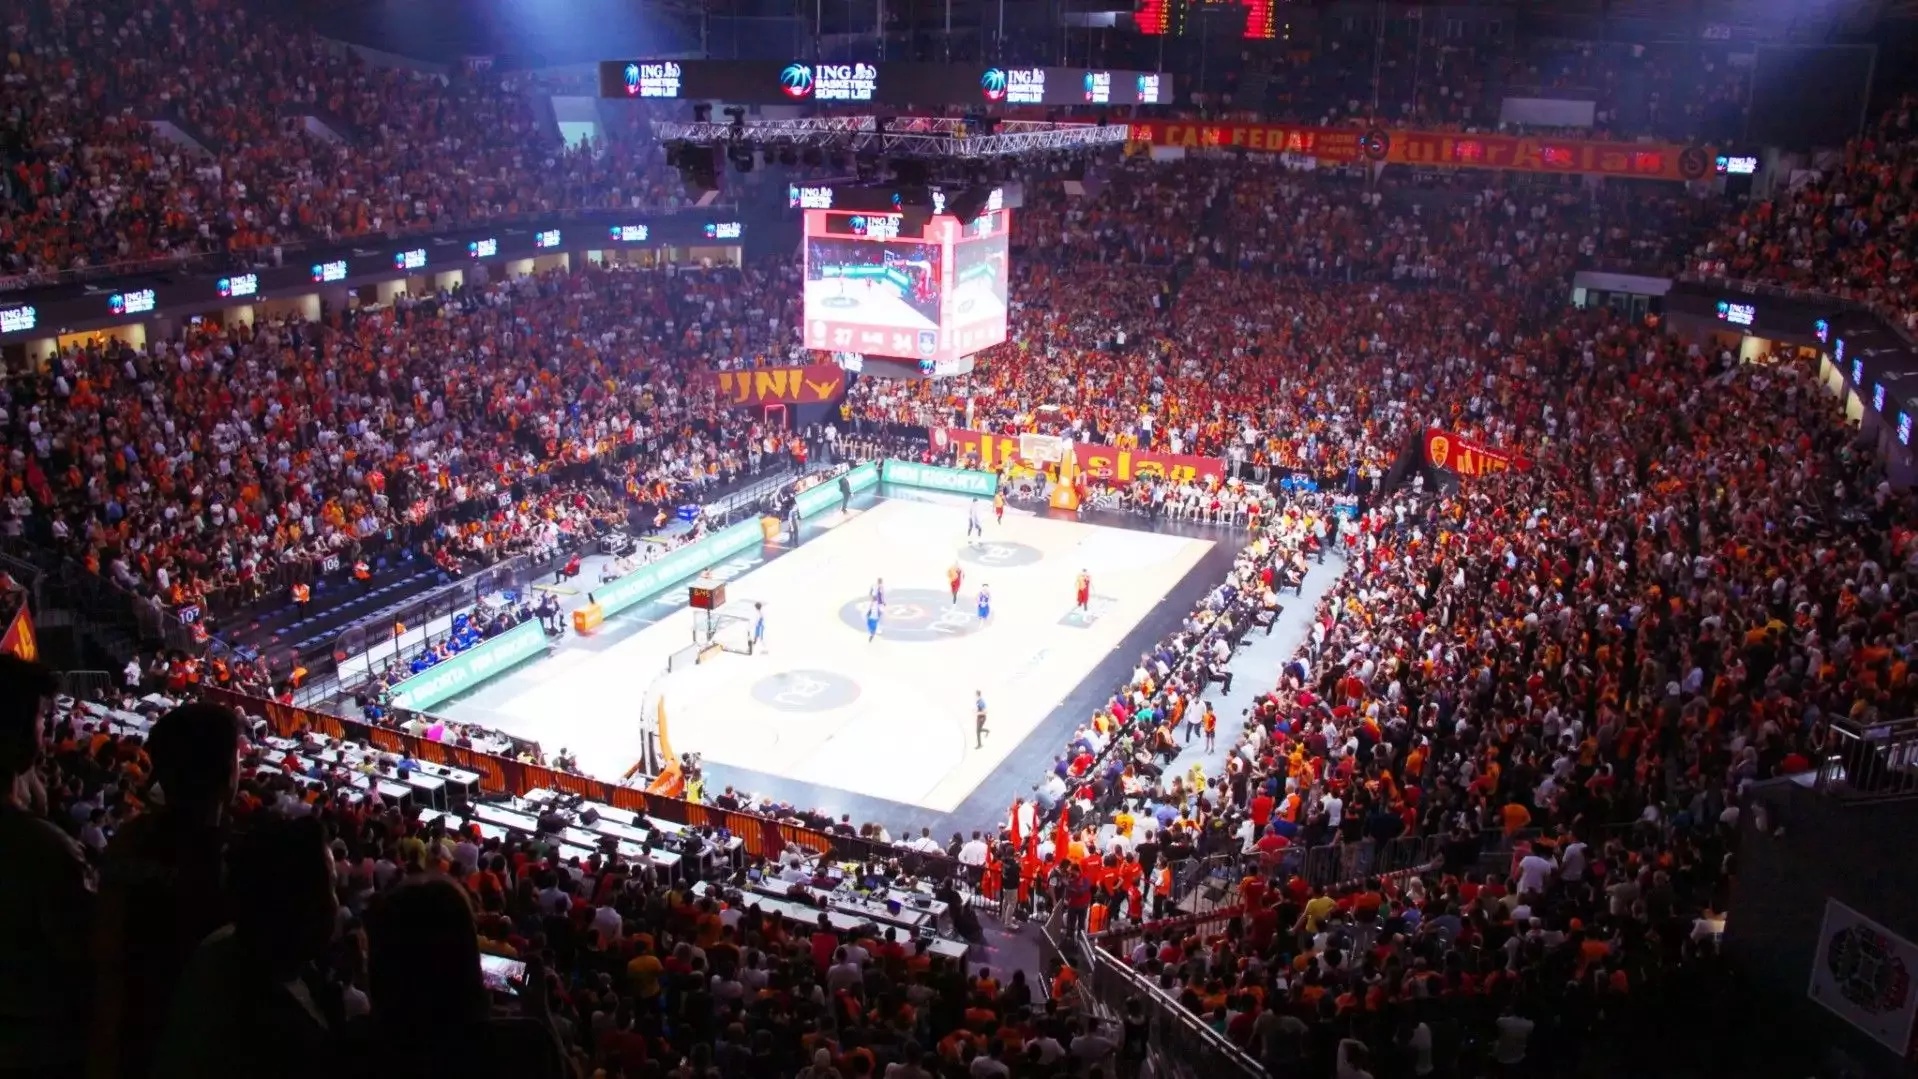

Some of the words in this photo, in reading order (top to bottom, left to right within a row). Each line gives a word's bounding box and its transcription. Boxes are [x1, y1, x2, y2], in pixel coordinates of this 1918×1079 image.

[816, 65, 851, 80] ING
[1008, 70, 1031, 84] ING
[322, 558, 340, 572] 106
[179, 607, 200, 625] 107
